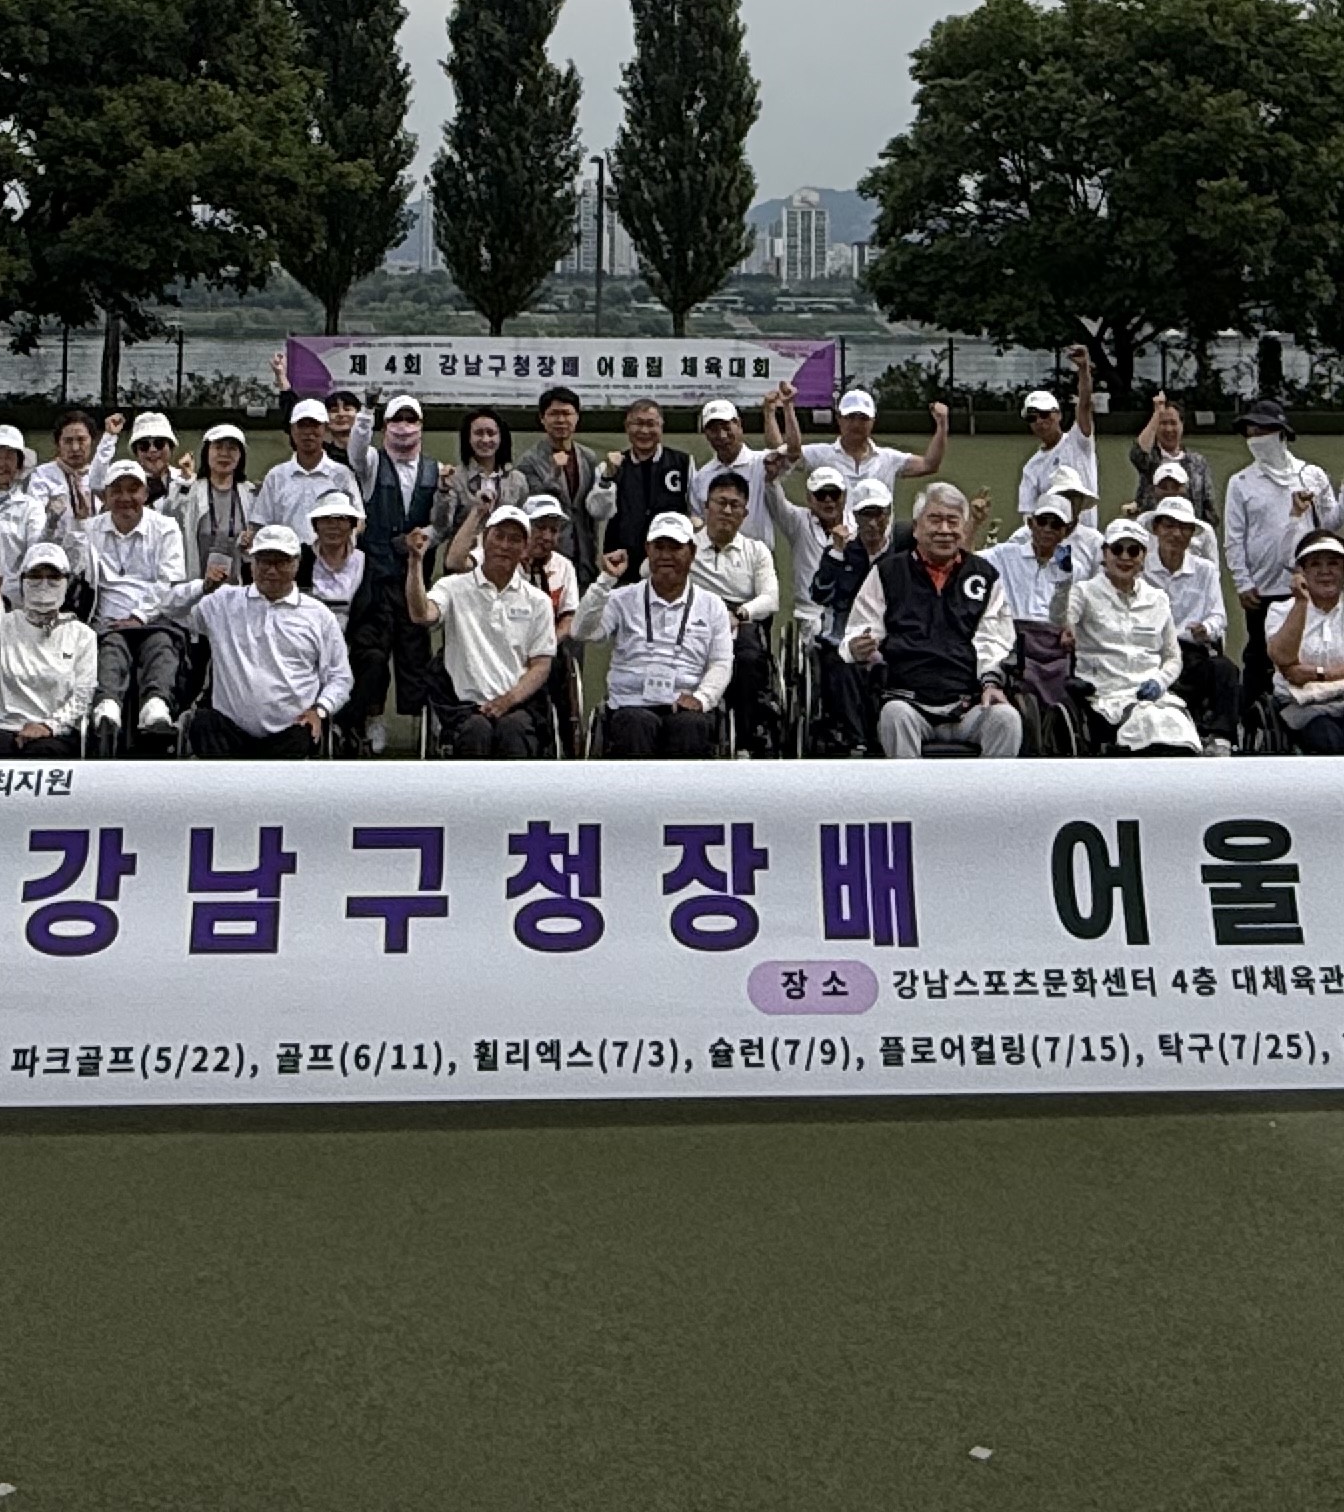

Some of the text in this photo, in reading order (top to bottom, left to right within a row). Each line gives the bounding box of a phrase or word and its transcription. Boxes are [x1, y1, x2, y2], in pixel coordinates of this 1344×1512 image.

[349, 354, 770, 378] 제 4회 강남구청장배 어울림 체육대회
[664, 470, 682, 492] G
[963, 574, 989, 601] G
[21, 821, 919, 957] 강남구청장배
[893, 967, 1157, 999] 강남스포츠문화센터
[1172, 967, 1217, 996] 4층
[11, 1043, 258, 1079] 파크골프(5/22),
[277, 1041, 456, 1077] 골프(6/11),
[474, 1038, 692, 1073] 휠리엑스(7/3),
[709, 1037, 864, 1071] 슐런(7/9),
[880, 1033, 1143, 1068] 플로어컬링(7/15),
[1159, 1031, 1329, 1065] 탁구(7/25),
